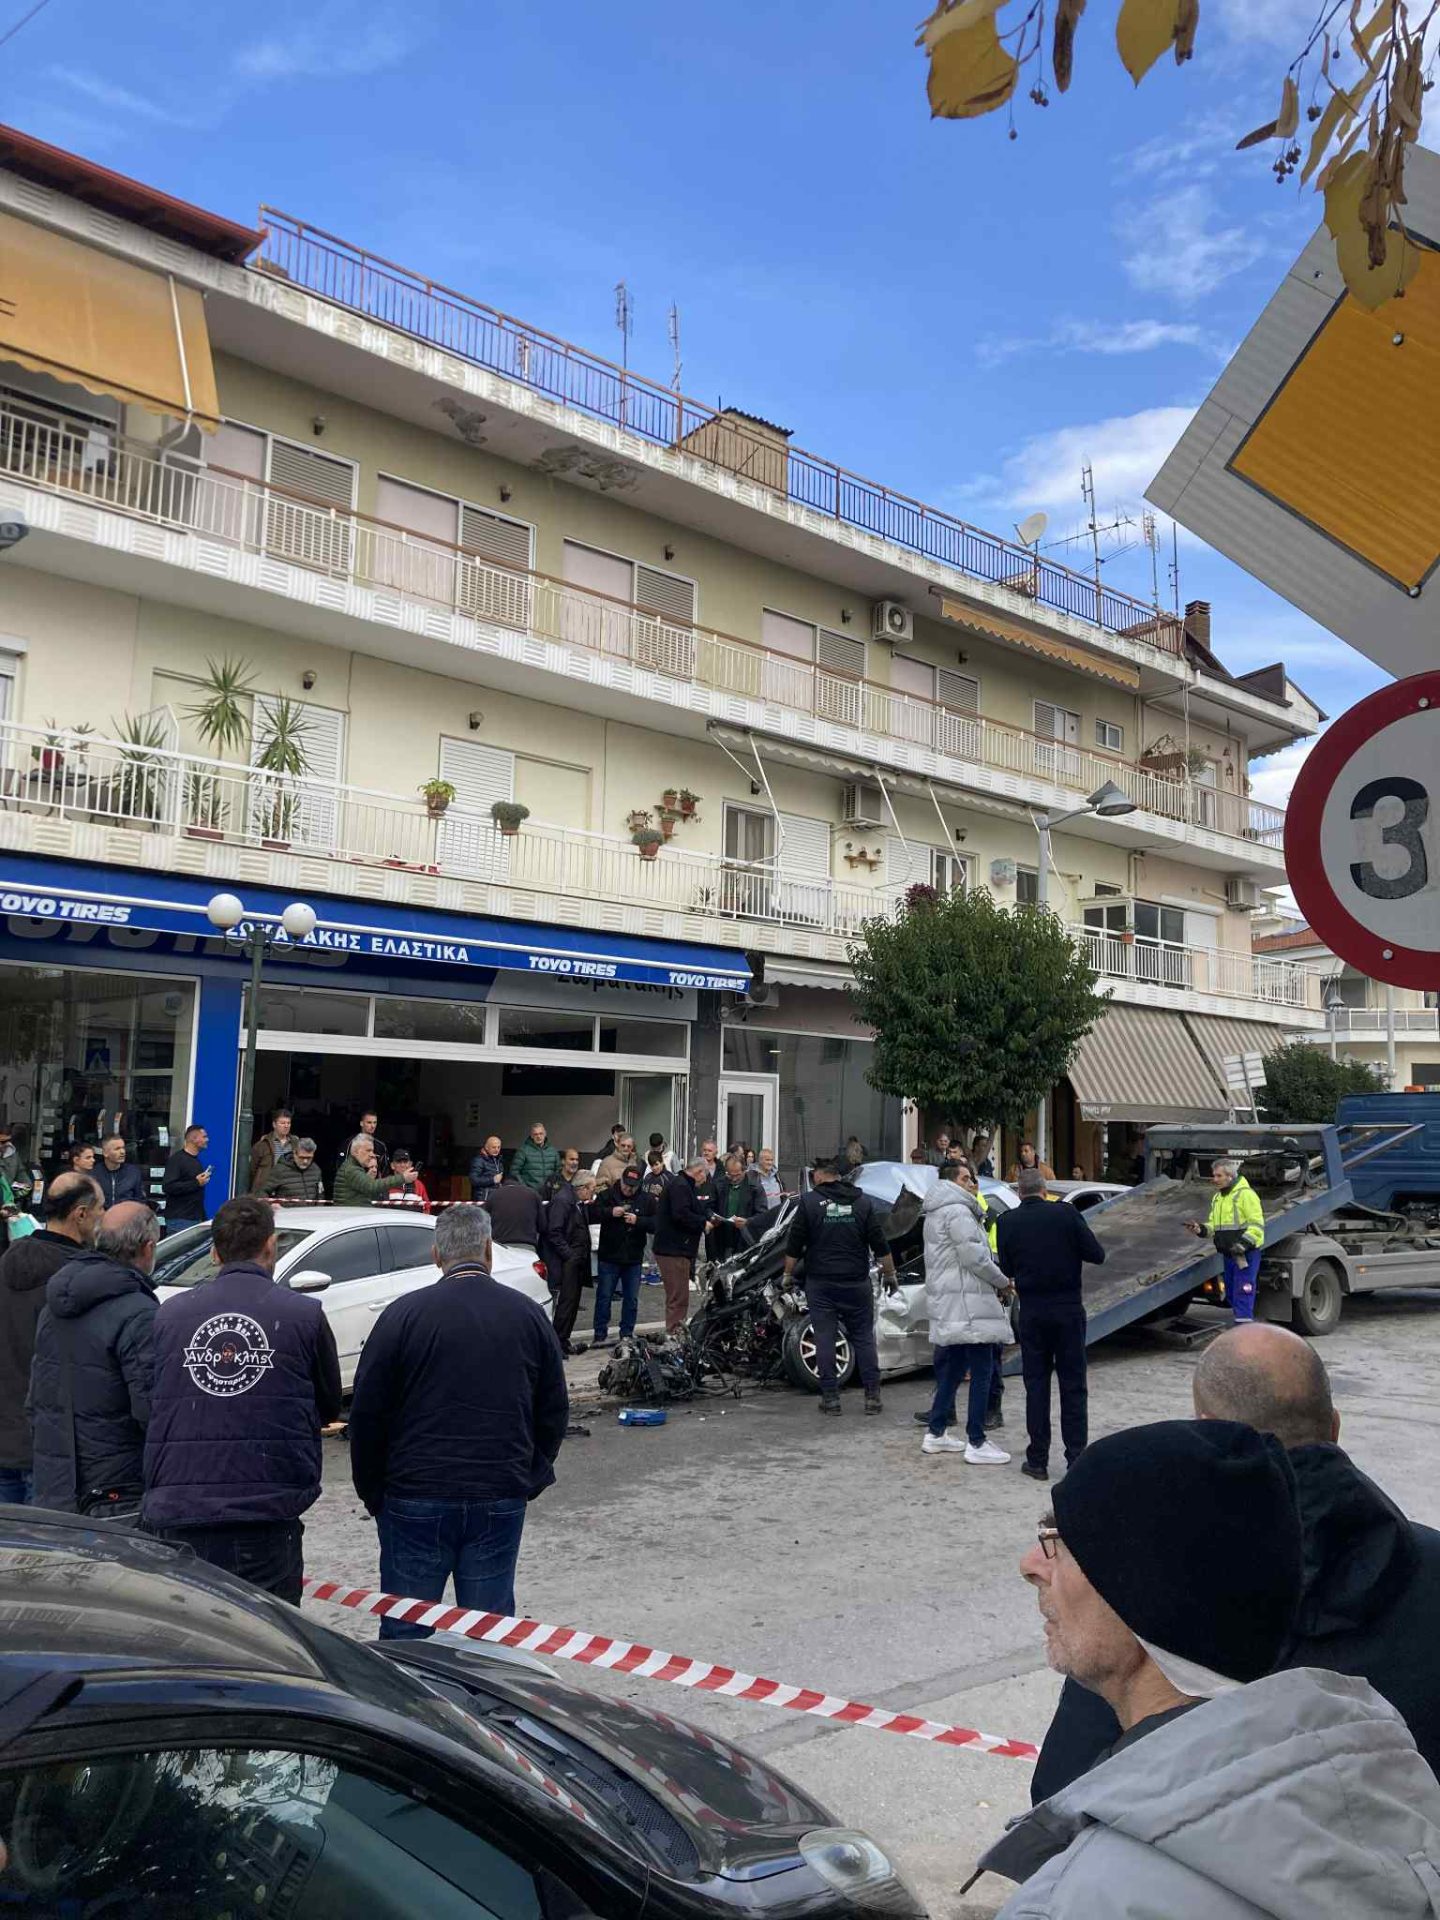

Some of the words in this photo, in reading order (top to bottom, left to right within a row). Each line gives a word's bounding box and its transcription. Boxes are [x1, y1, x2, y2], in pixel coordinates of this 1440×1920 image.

[1350, 776, 1429, 900] 3
[0, 893, 57, 915] OYO
[60, 900, 131, 922] TIRES
[371, 937, 469, 962] ΕΛΑΣΤΙΚΑ
[529, 956, 572, 972] TOYO
[573, 961, 617, 977] TIRES
[669, 971, 706, 987] TOYO
